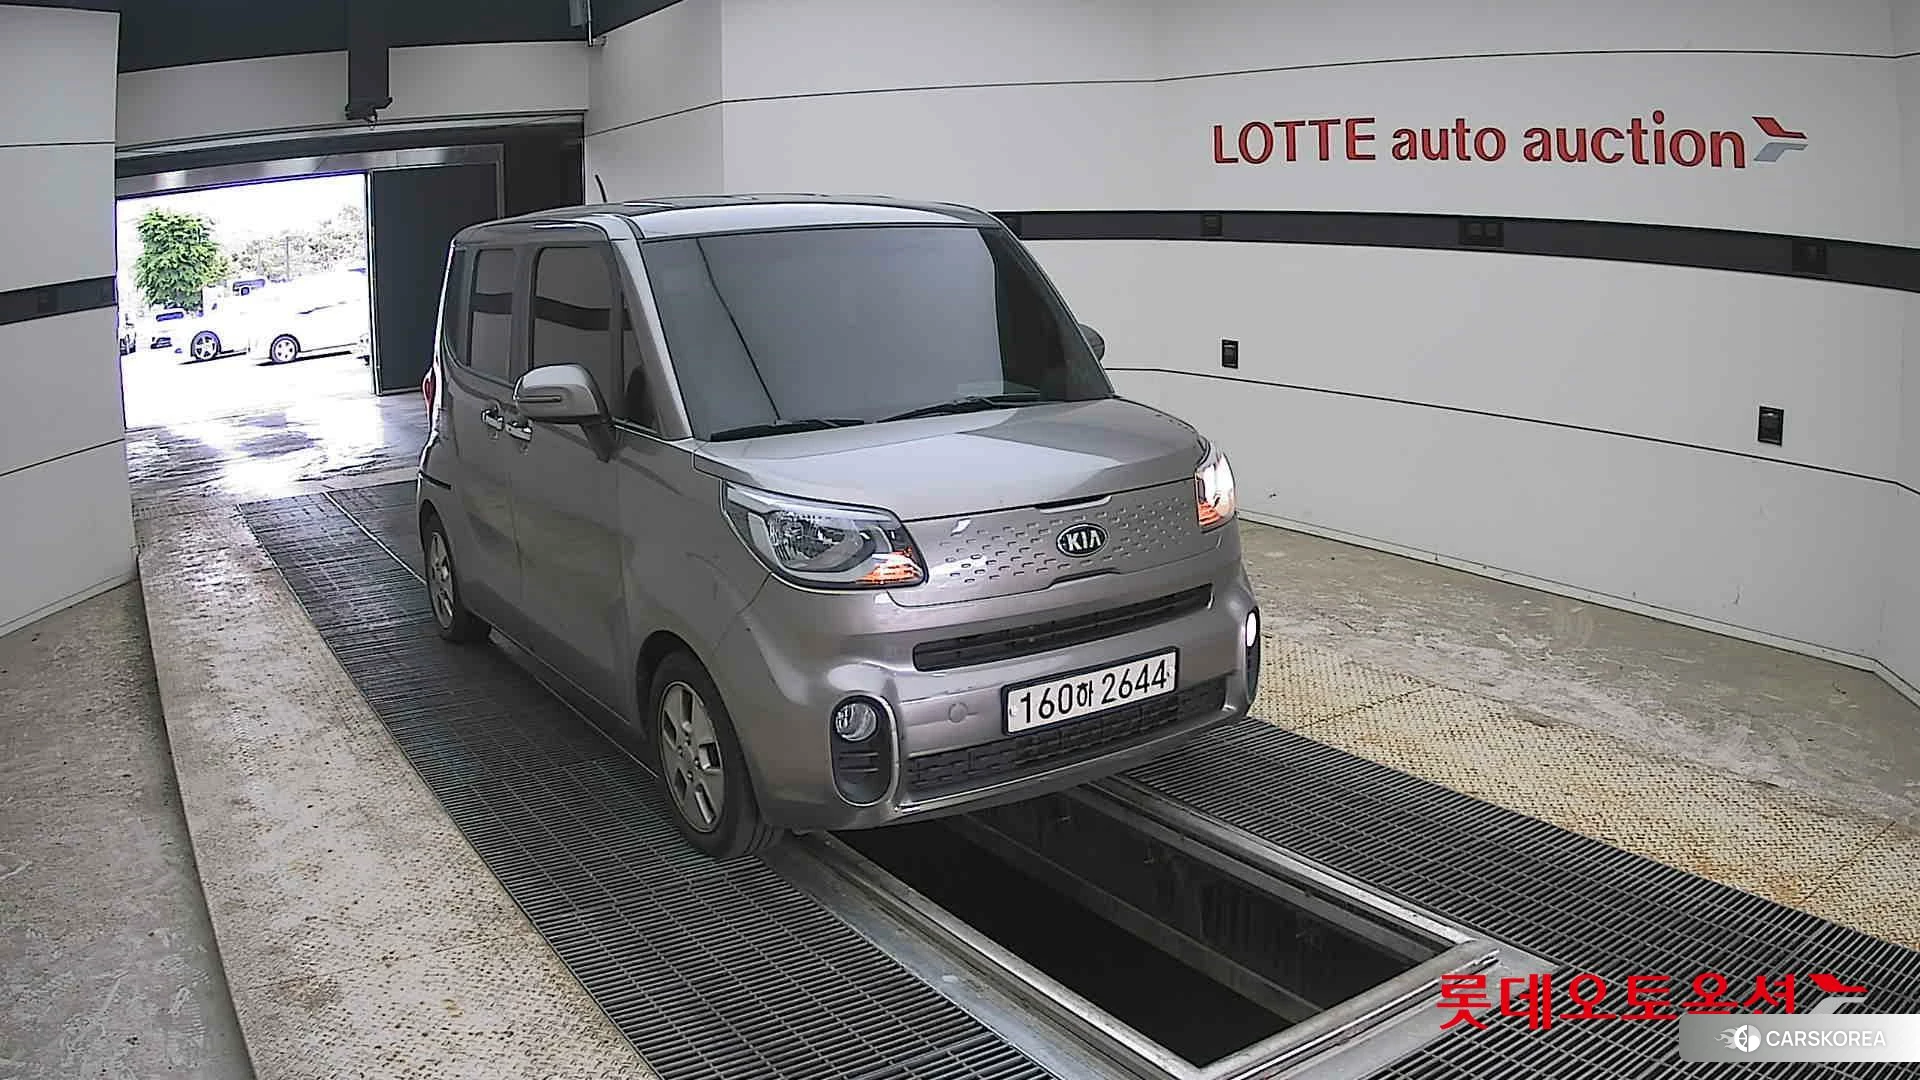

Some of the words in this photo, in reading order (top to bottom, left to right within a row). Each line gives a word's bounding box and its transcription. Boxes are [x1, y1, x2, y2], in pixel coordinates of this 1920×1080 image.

[1213, 116, 1376, 165] LOTTE
[1391, 117, 1506, 162] auto
[1522, 109, 1746, 169] auction
[1066, 534, 1102, 552] KIA
[1020, 680, 1094, 724] 160하
[1101, 659, 1168, 705] 2644
